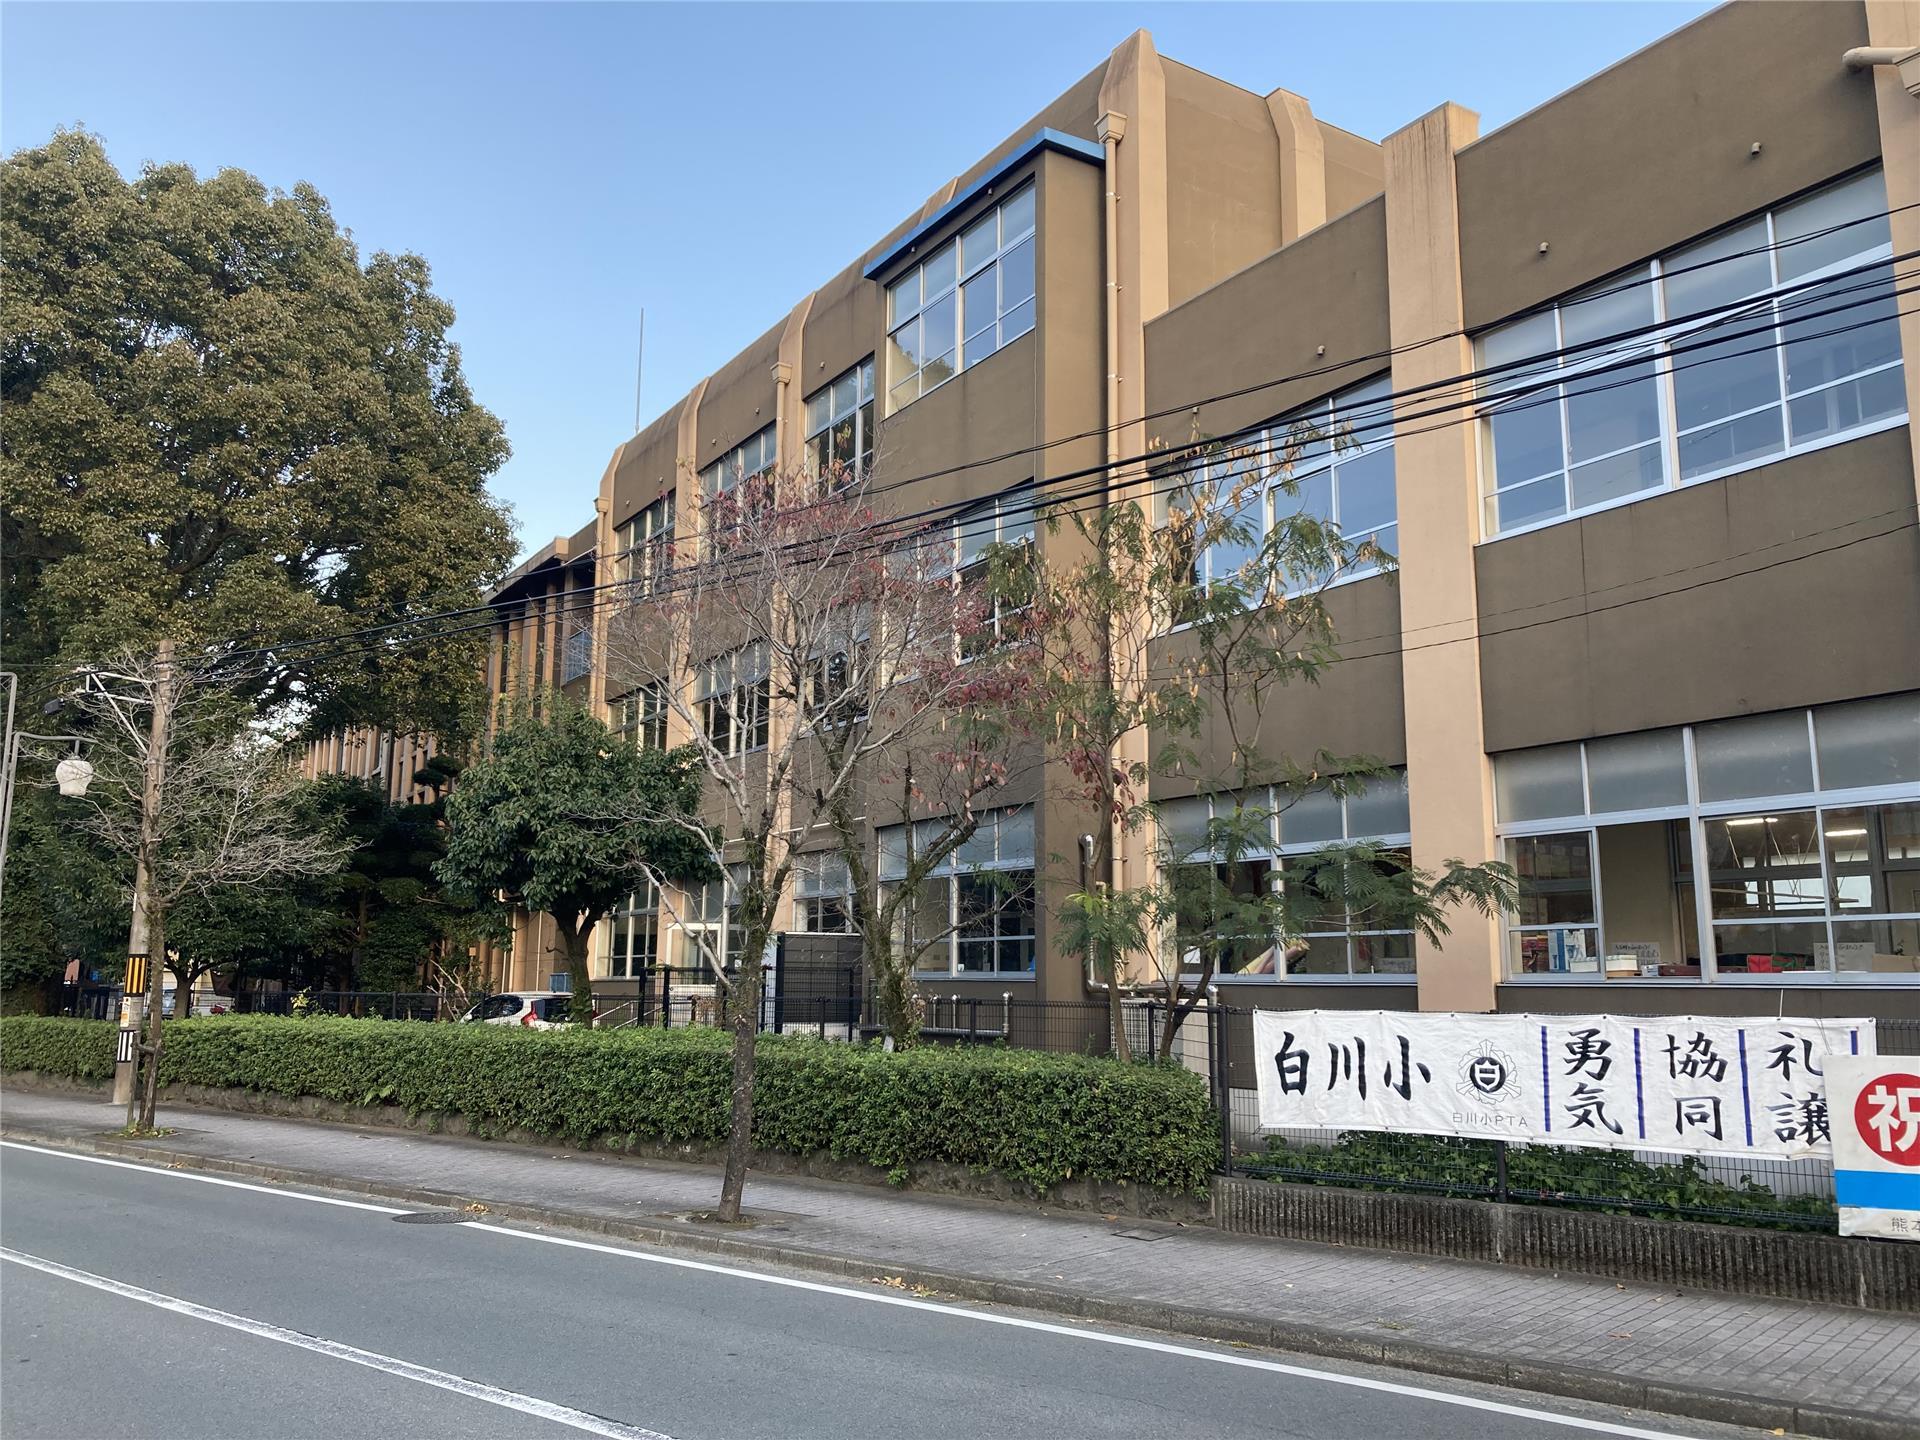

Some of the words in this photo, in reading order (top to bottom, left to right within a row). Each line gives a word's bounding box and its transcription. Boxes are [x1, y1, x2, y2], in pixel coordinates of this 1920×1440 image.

[1274, 1031, 1431, 1101] 白川小
[1563, 1028, 1623, 1135] 勇気
[1660, 1031, 1729, 1141] 協同
[1765, 1031, 1831, 1146] 礼譲
[1452, 1111, 1529, 1127] 白川小PTA
[1867, 1084, 1920, 1153] 祝
